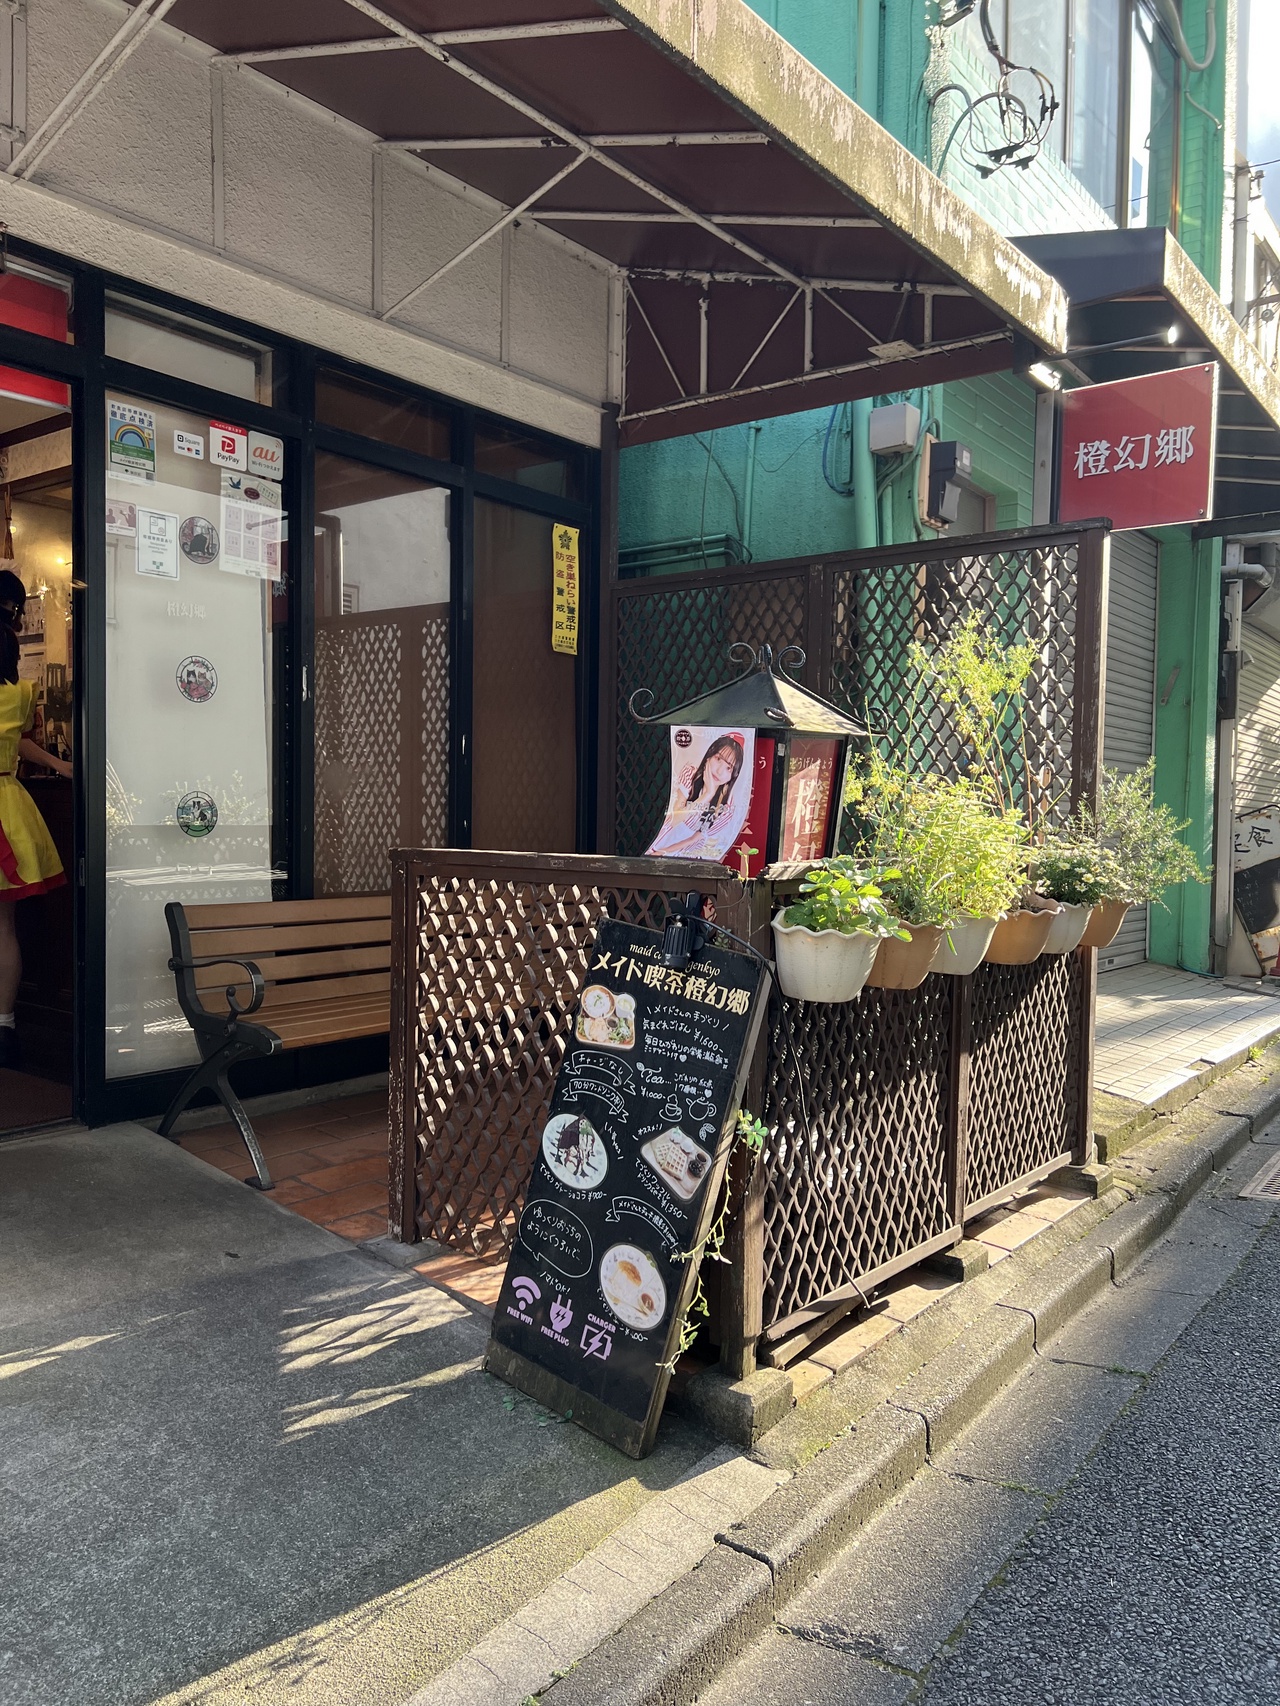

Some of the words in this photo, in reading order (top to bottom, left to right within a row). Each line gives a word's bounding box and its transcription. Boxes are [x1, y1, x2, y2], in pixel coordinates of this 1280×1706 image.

[184, 437, 200, 446] Square
[217, 452, 240, 465] PayPay
[252, 446, 280, 463] au
[1073, 425, 1196, 480] 橙幻郷
[565, 554, 576, 632] 空き巣ねらい警戒中
[629, 942, 652, 957] maid
[591, 951, 751, 1016] メイド喫茶橙幻郷
[642, 1018, 692, 1034] 気まぐれごはん
[533, 1206, 582, 1242] ゆっくりおうちの
[506, 1306, 521, 1320] FREE
[520, 1312, 534, 1326] WIFI
[587, 1313, 617, 1334] CHARGER
[540, 1325, 554, 1340] FREE
[553, 1331, 570, 1347] PLUG
